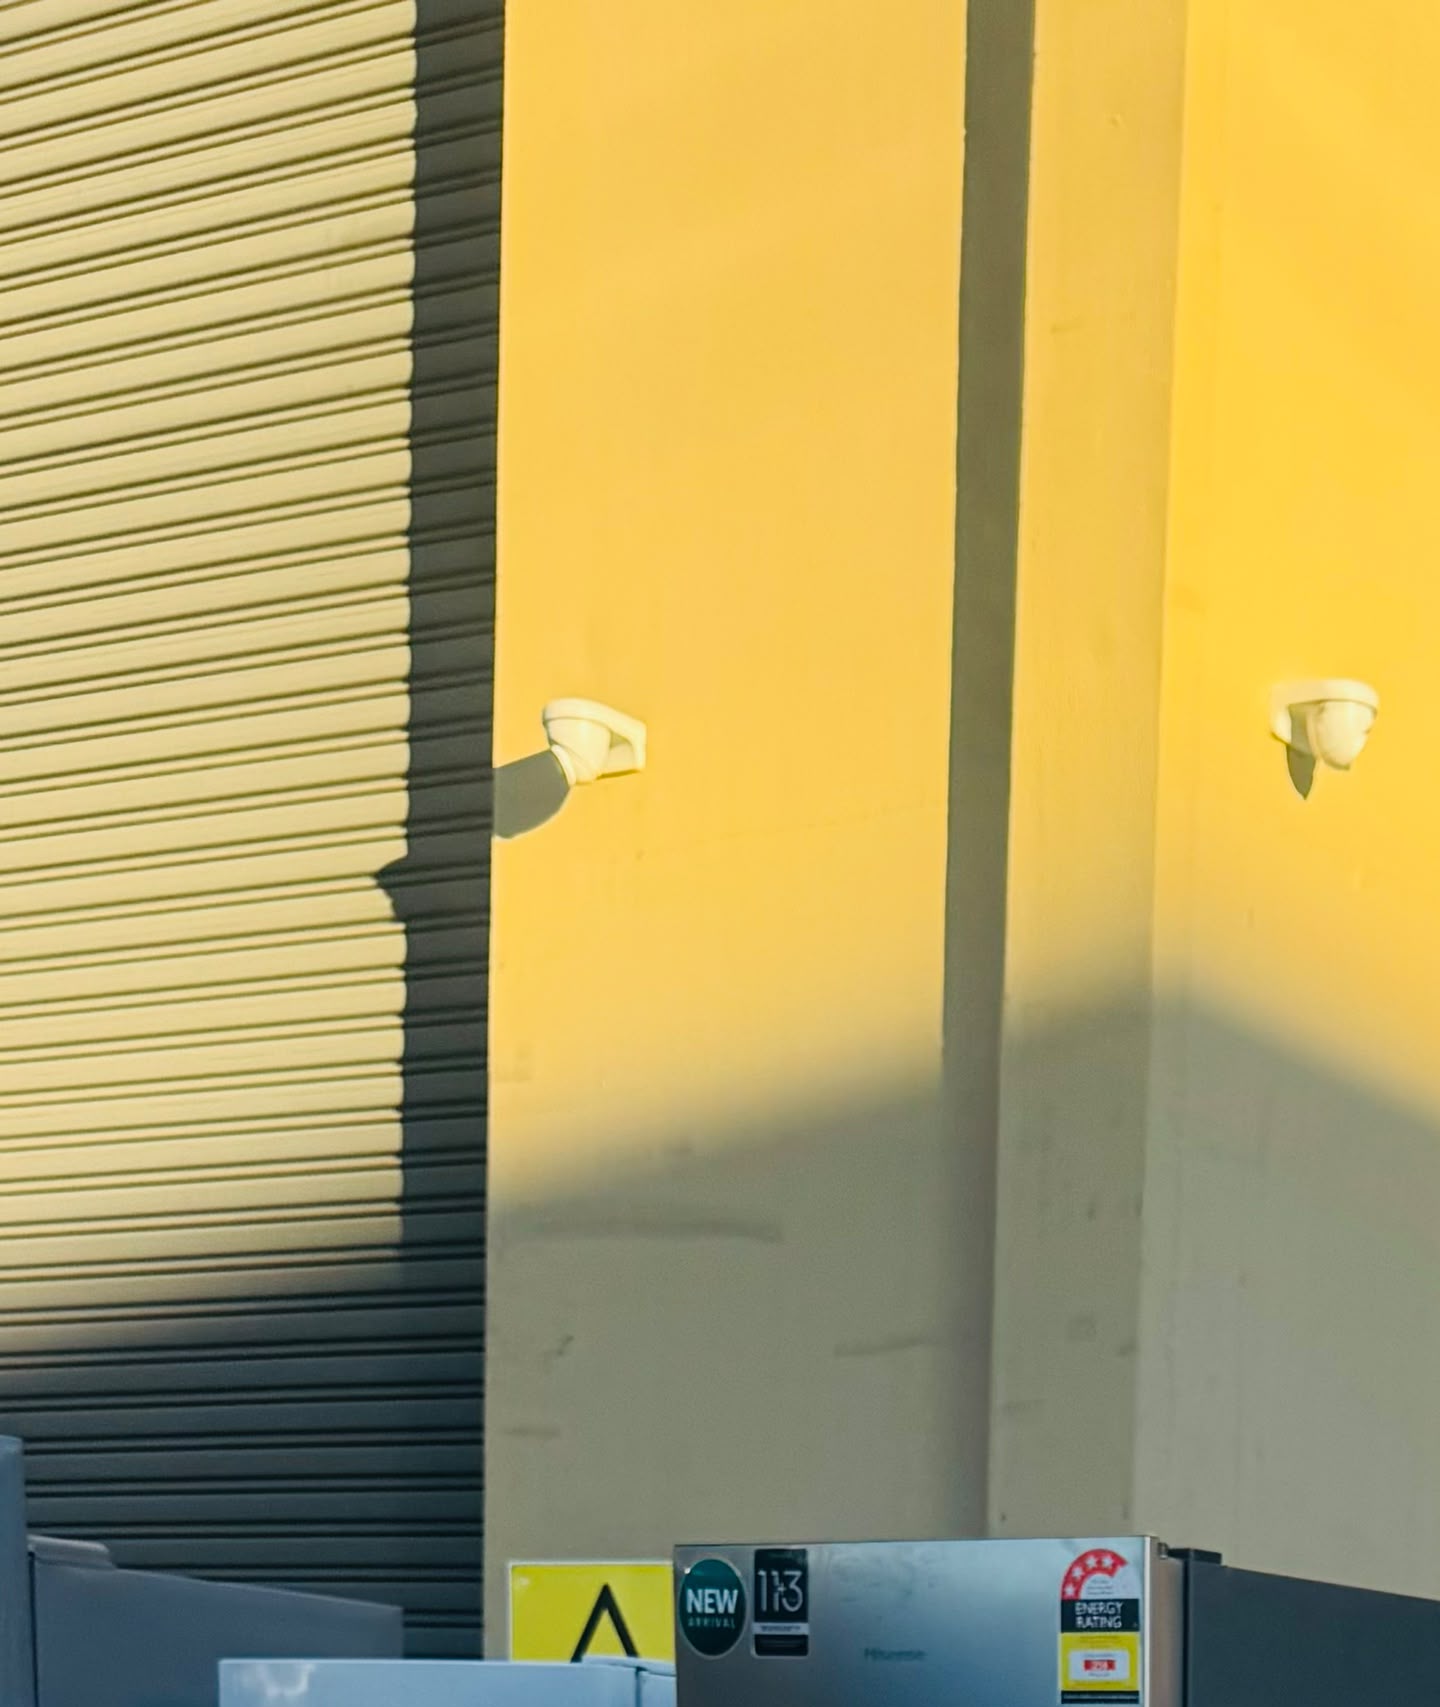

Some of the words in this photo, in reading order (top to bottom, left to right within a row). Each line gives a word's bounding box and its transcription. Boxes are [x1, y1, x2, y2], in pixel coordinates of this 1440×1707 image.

[686, 1588, 738, 1614] NEW
[1075, 1602, 1123, 1615] ENERGY
[688, 1617, 735, 1628] ARRIVAL
[1076, 1616, 1122, 1629] RATING
